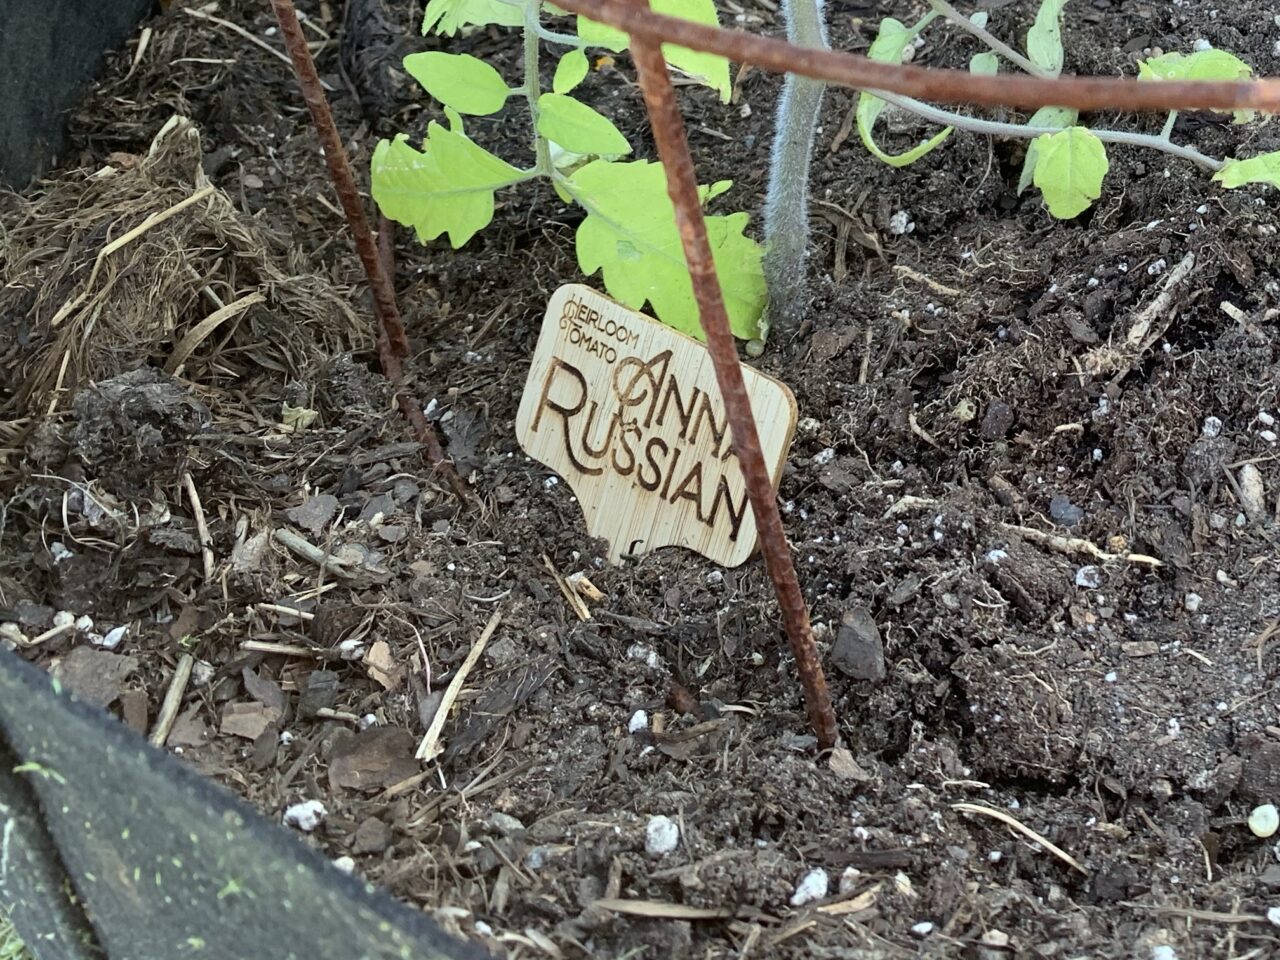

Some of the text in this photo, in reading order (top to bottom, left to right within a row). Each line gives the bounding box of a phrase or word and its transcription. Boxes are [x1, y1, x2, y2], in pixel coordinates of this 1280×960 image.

[559, 314, 617, 364] TOMATO
[562, 292, 640, 350] HEIRLOOM
[530, 355, 749, 542] RUSSIAN
